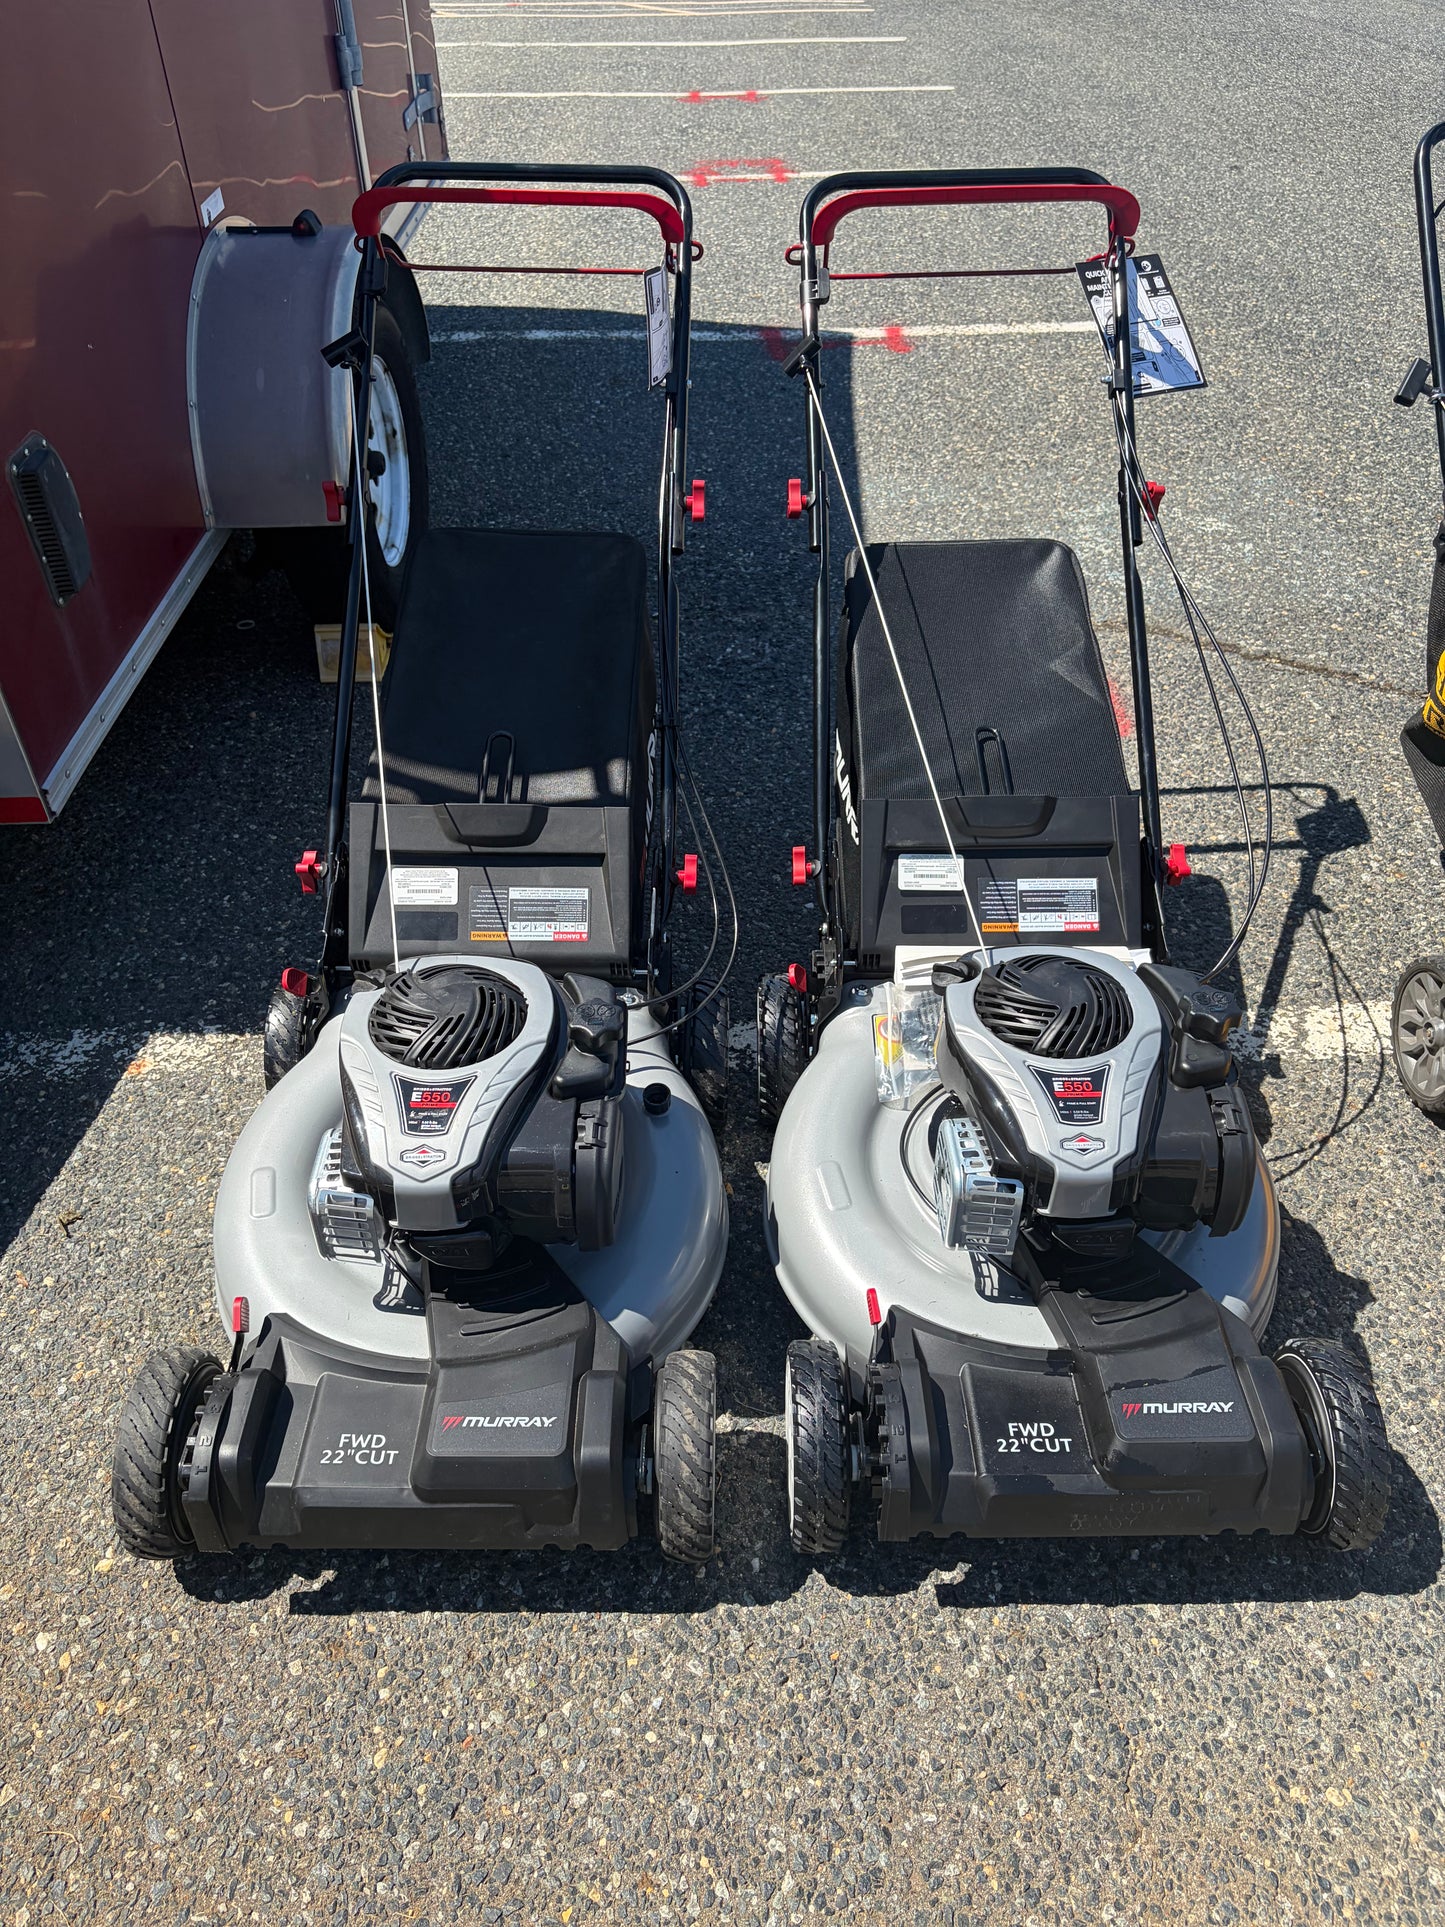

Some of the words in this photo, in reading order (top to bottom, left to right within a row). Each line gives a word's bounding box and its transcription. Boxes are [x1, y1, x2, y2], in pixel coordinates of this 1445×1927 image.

[1085, 269, 1106, 279] QUICK
[1053, 1081, 1093, 1092] E550
[411, 1091, 451, 1102] E550
[1142, 1401, 1235, 1414] MURRAY
[462, 1416, 557, 1428] MURRAY
[1007, 1422, 1055, 1437] FWD
[338, 1433, 386, 1448] FWD
[996, 1437, 1073, 1453] 22"CUT
[319, 1449, 399, 1465] 22"CUT
